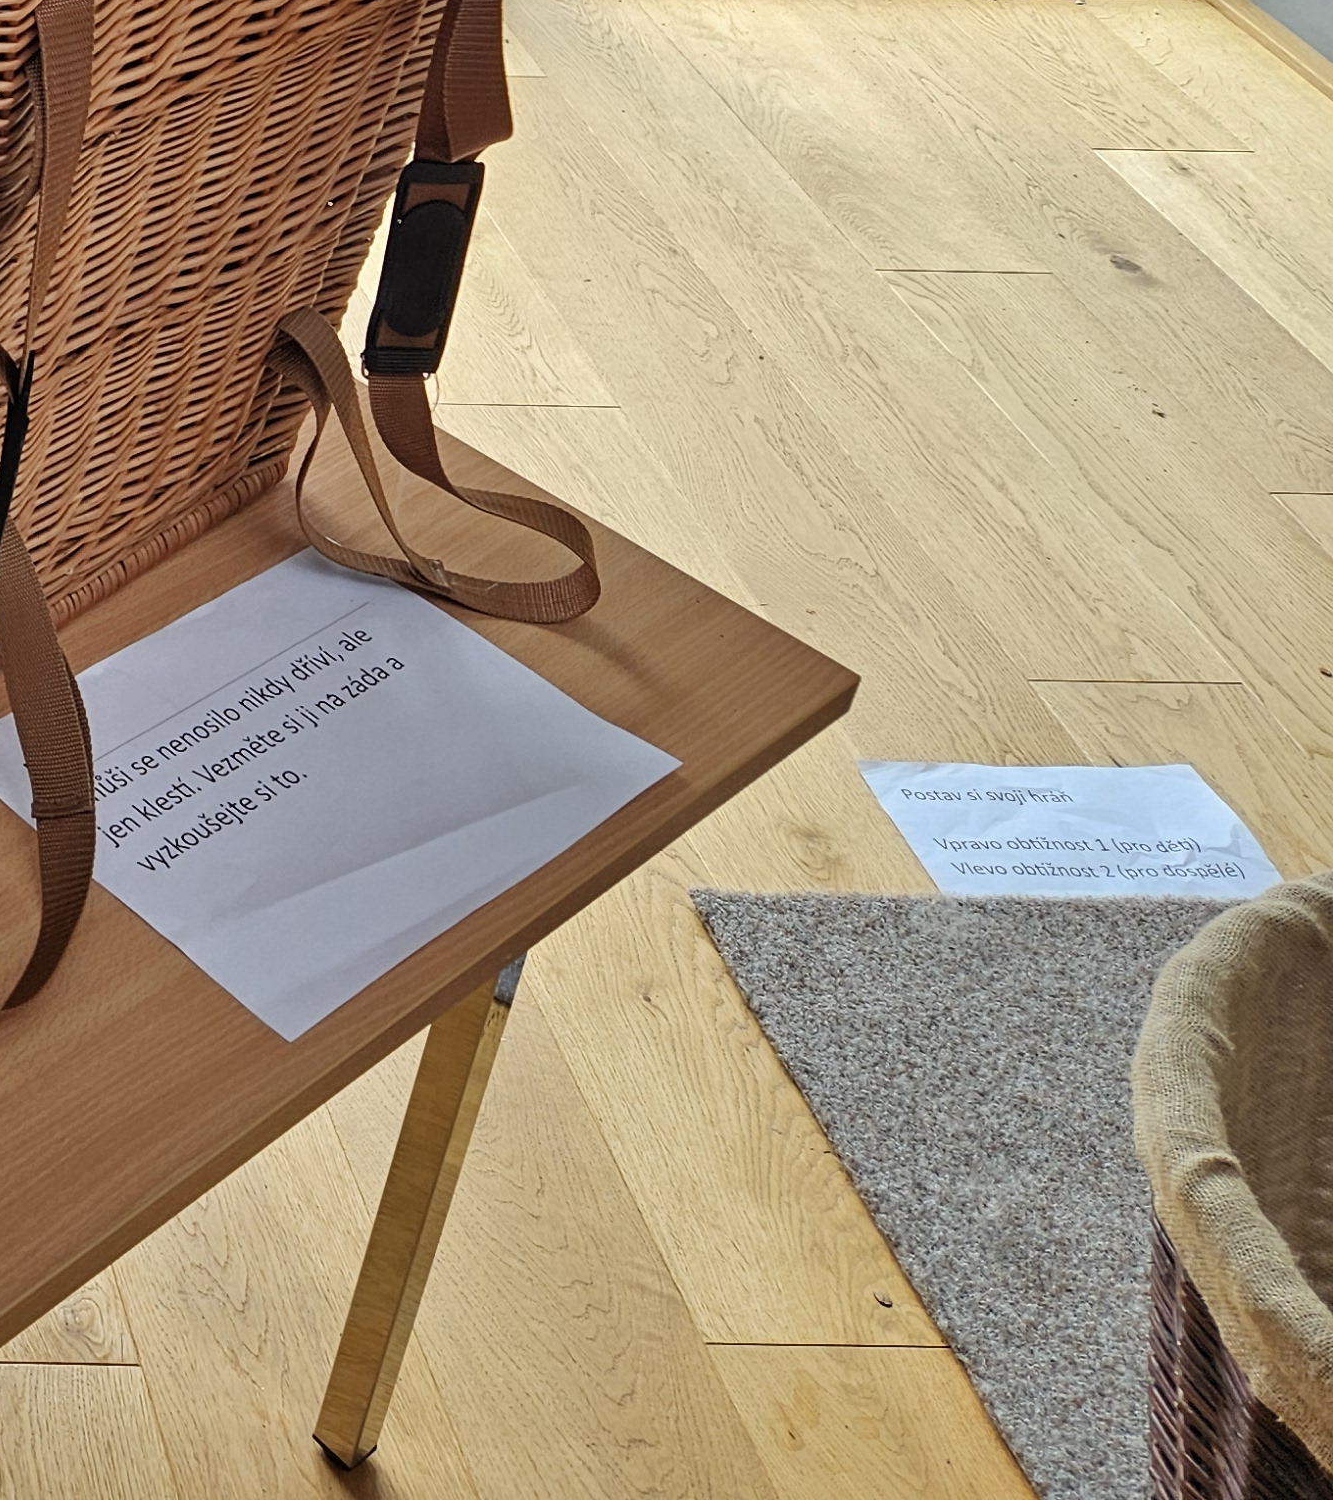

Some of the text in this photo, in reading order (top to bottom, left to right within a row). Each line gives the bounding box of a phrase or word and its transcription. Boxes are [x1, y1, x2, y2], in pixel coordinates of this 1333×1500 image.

[131, 755, 159, 775] se
[156, 708, 241, 760] nenosilo
[238, 676, 295, 712] nikdy
[290, 646, 344, 681] dříví,
[338, 630, 372, 652] ale
[97, 657, 405, 848] jen klestí. Vezměte si ji na záda a
[137, 770, 308, 872] vyzkoušejte si to.
[901, 788, 961, 801] Postav
[966, 789, 983, 801] si
[986, 790, 1027, 805] svoji
[933, 837, 1002, 852] Vpravo
[1096, 839, 1110, 851] 1
[1111, 838, 1152, 854] (pro
[1156, 837, 1201, 853] děti)
[951, 862, 1007, 875] Vlevo
[1100, 865, 1115, 878] 2
[1117, 865, 1158, 880] (pro
[1163, 862, 1245, 879] dospělé)
